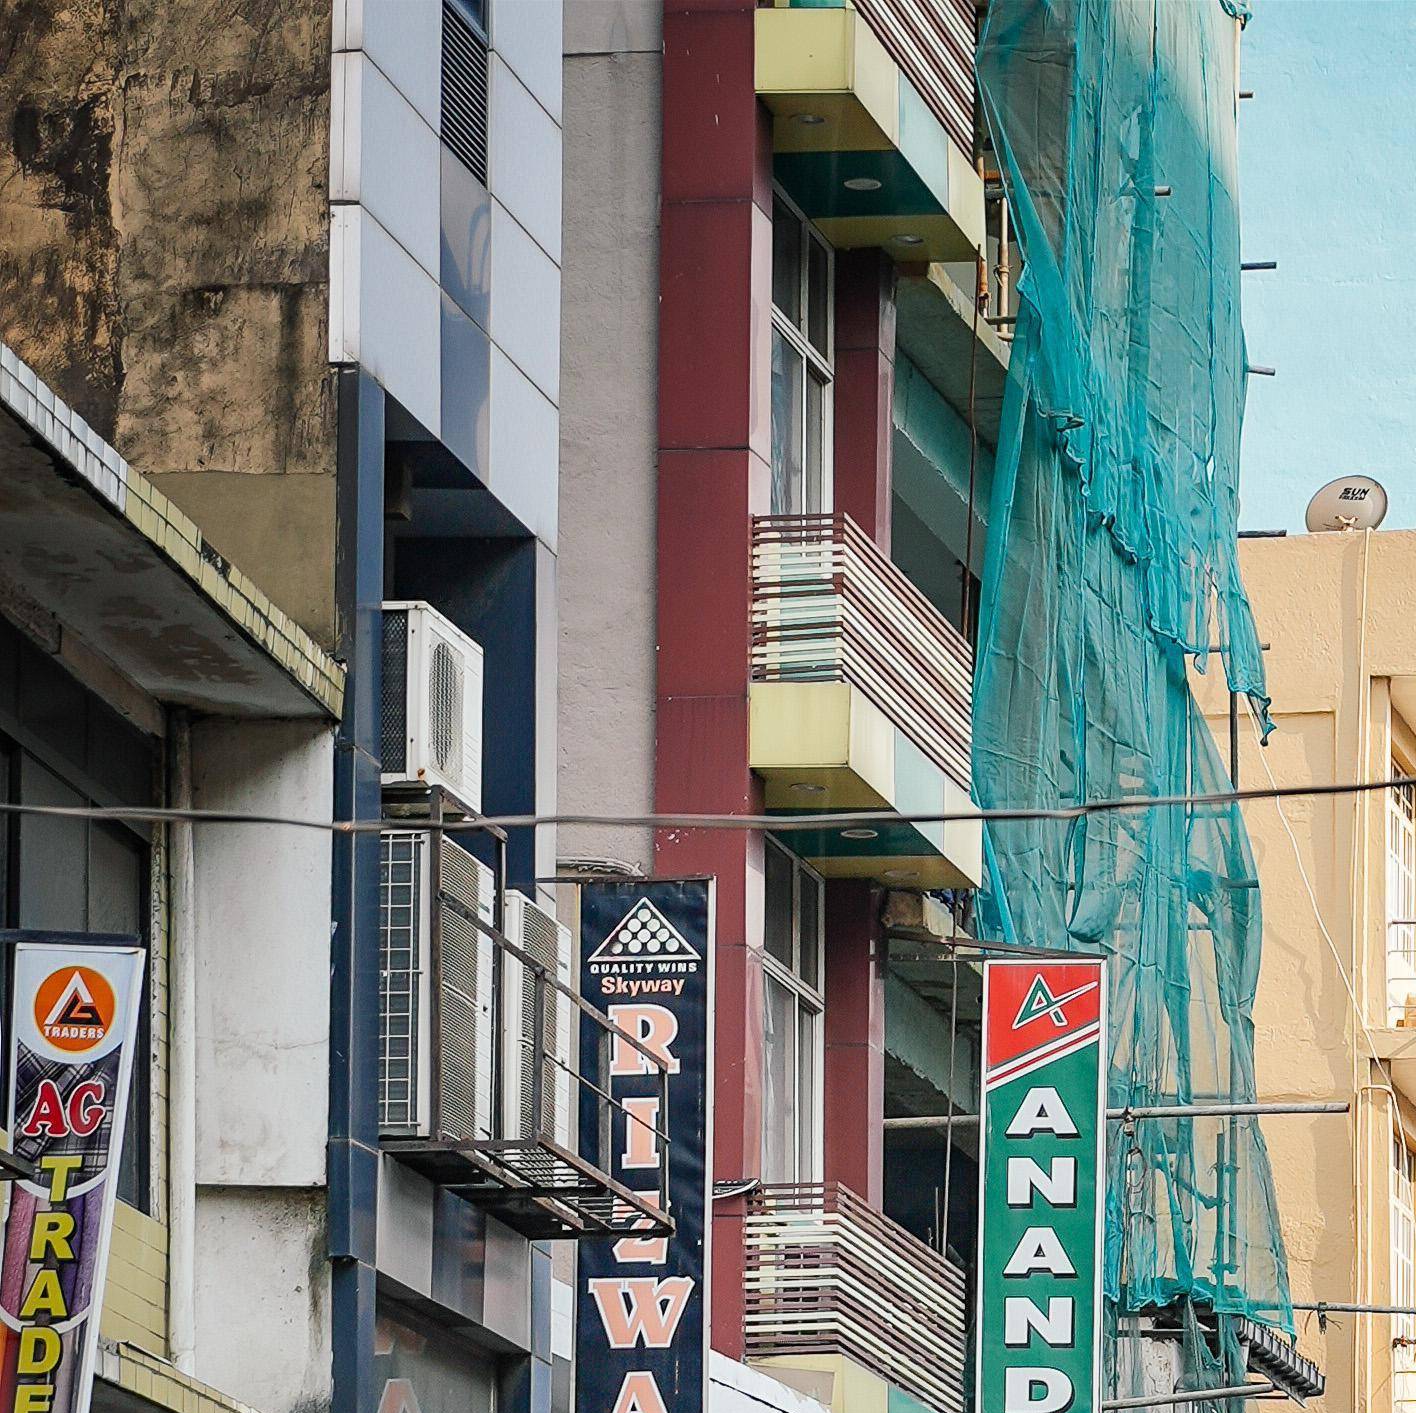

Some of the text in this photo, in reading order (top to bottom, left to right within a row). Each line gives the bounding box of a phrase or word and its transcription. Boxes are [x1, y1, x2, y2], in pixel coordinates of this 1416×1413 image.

[1341, 487, 1370, 496] SUN
[590, 962, 698, 974] QUALITY WINS
[601, 976, 685, 997] Skyway
[43, 1025, 105, 1039] TRADERS
[22, 1079, 106, 1138] AG
